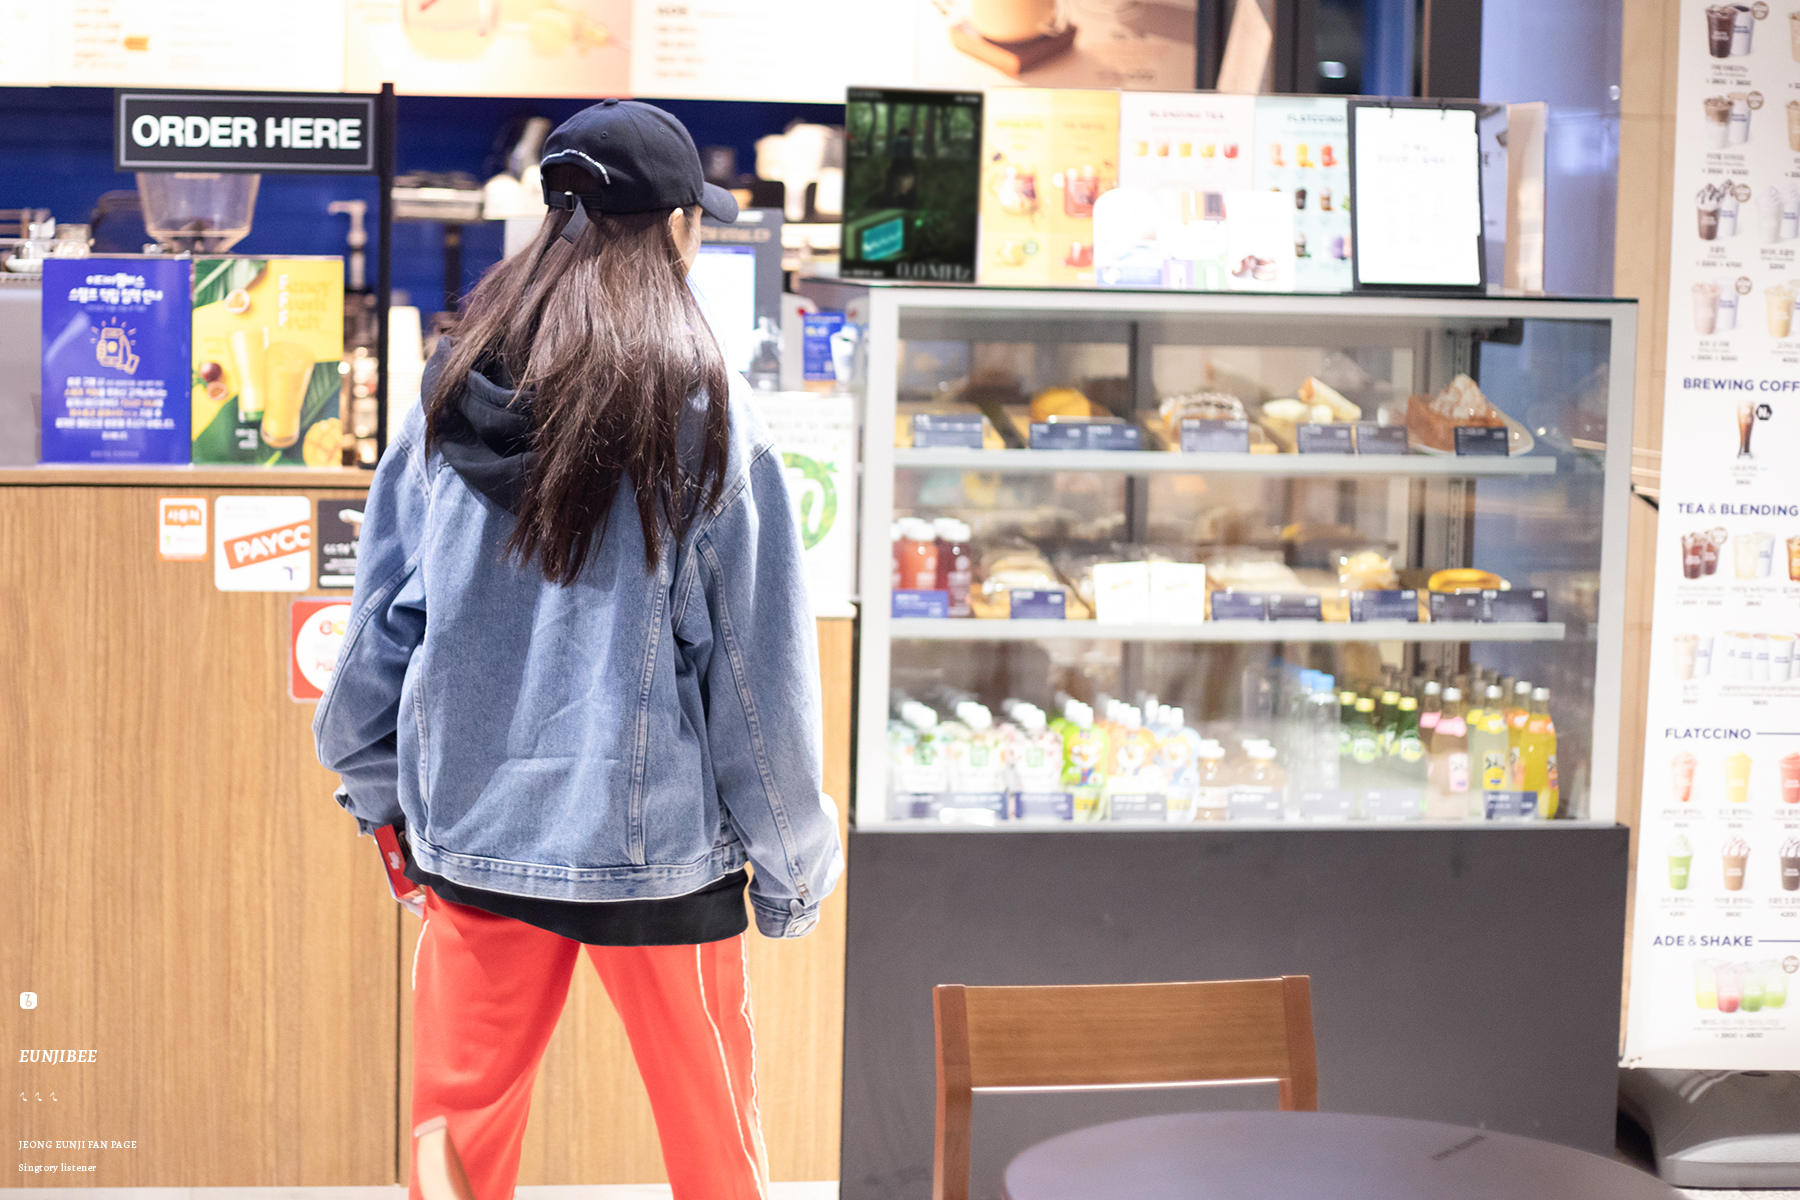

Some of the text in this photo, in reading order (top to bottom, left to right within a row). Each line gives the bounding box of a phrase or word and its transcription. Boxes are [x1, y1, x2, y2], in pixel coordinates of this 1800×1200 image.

[132, 115, 362, 150] ORDER HERE
[1683, 377, 1754, 391] BREWING
[1678, 503, 1705, 514] TEA
[1721, 504, 1798, 516] BLENDING
[1665, 728, 1751, 740] FLATCCINO
[1653, 935, 1685, 947] ADE
[1700, 935, 1754, 947] SHAKE
